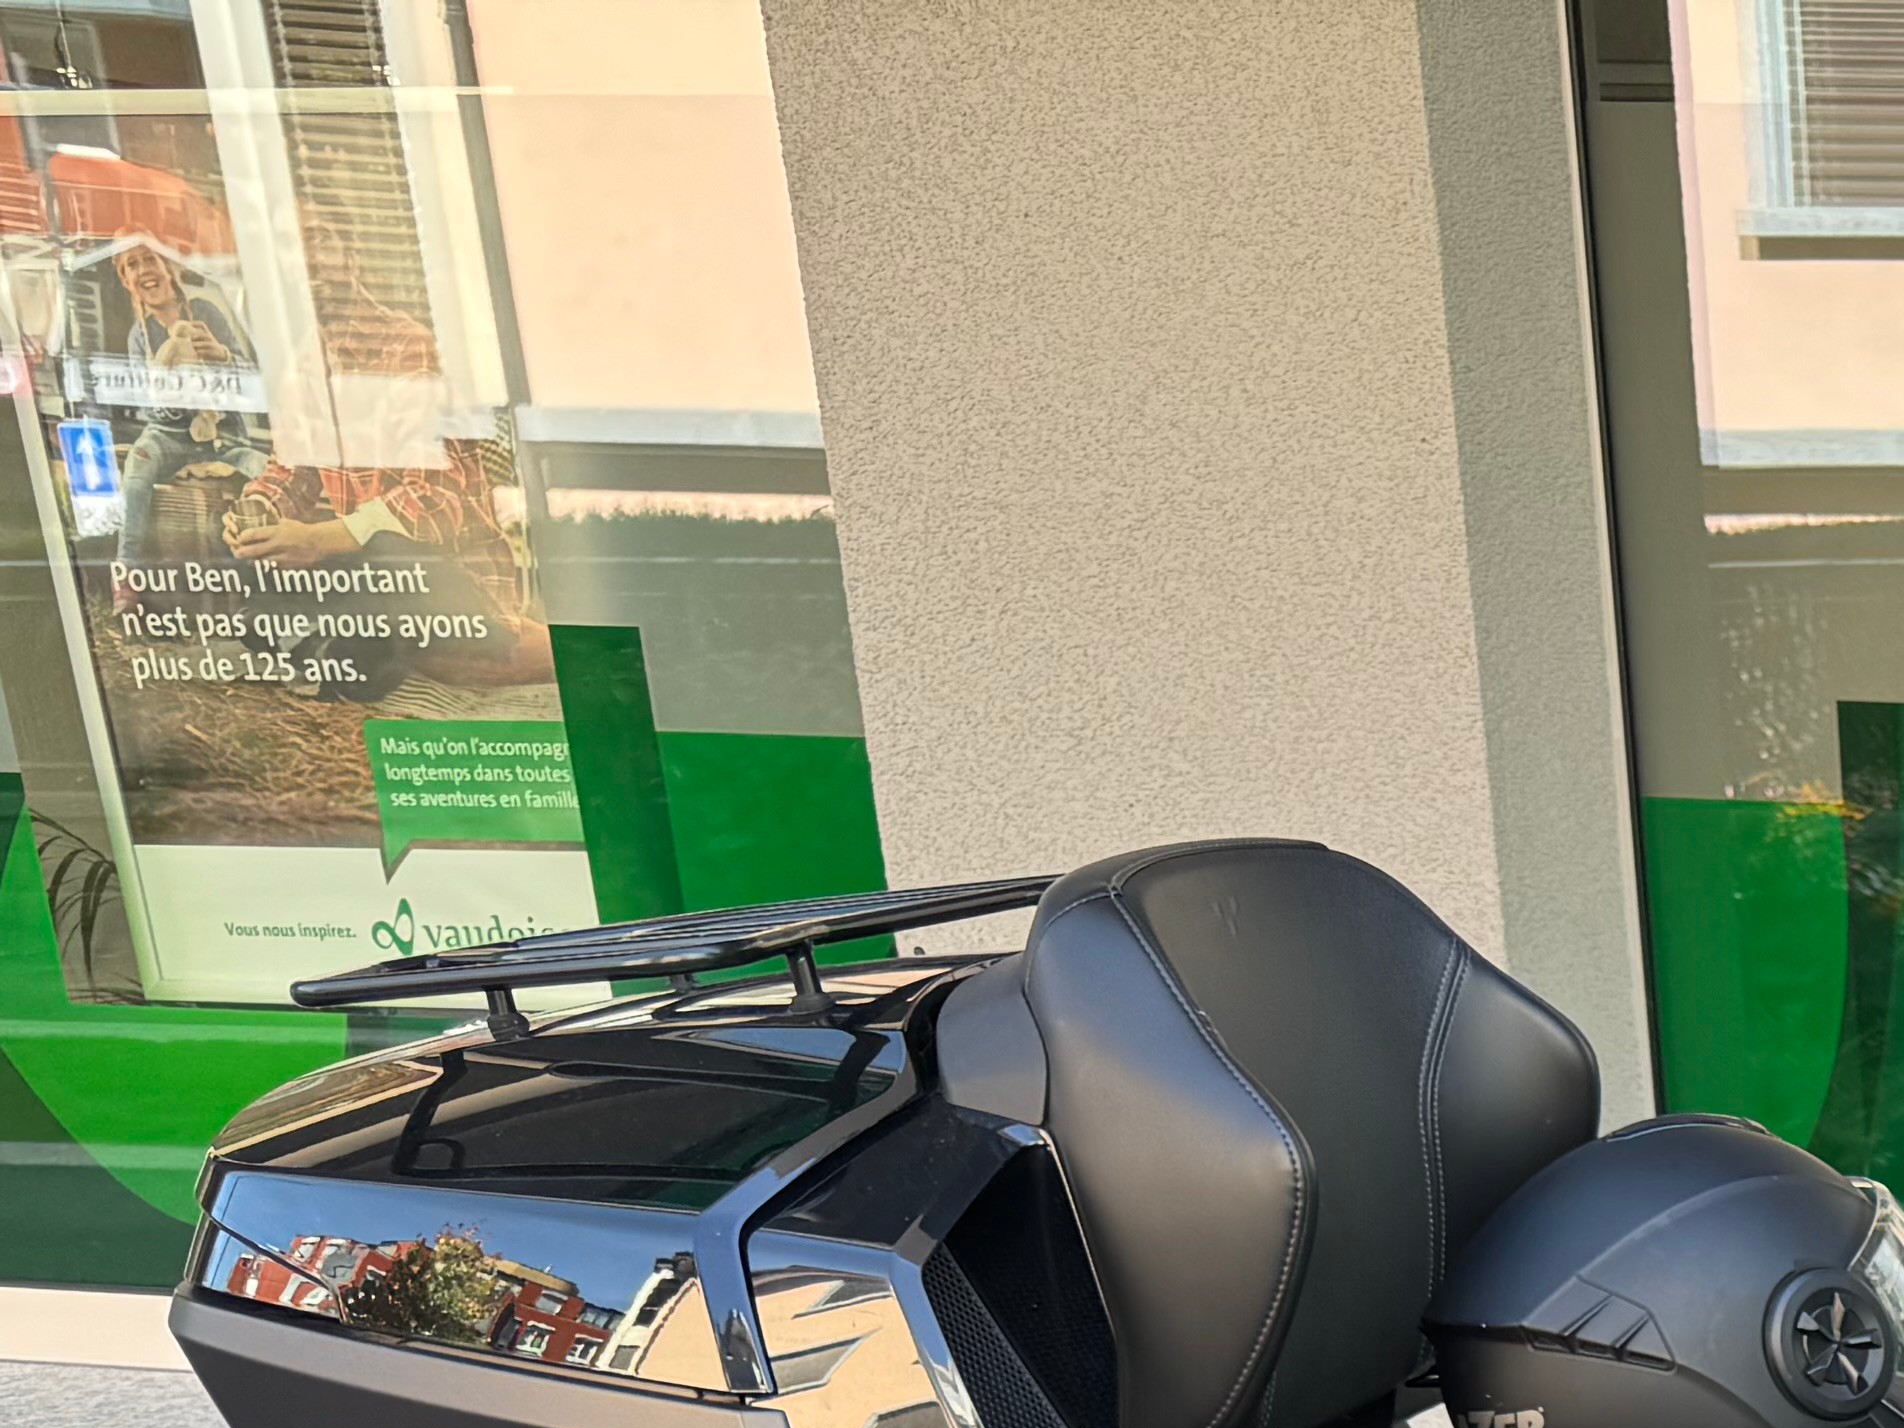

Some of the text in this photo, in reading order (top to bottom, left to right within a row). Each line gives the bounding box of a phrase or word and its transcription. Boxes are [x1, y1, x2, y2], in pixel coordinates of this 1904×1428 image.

[110, 560, 430, 602] Pour Ben, l'important
[122, 604, 488, 649] n'est pas que nous ayons
[131, 648, 368, 689] plus de 125 ans.
[380, 738, 420, 756] Mais
[422, 737, 468, 760] qu'on
[384, 763, 571, 787] longtemps dans toutes
[390, 792, 417, 808] ses
[420, 791, 497, 809] aventures
[499, 793, 521, 808] en
[224, 921, 357, 942] Vous nous inspirez.
